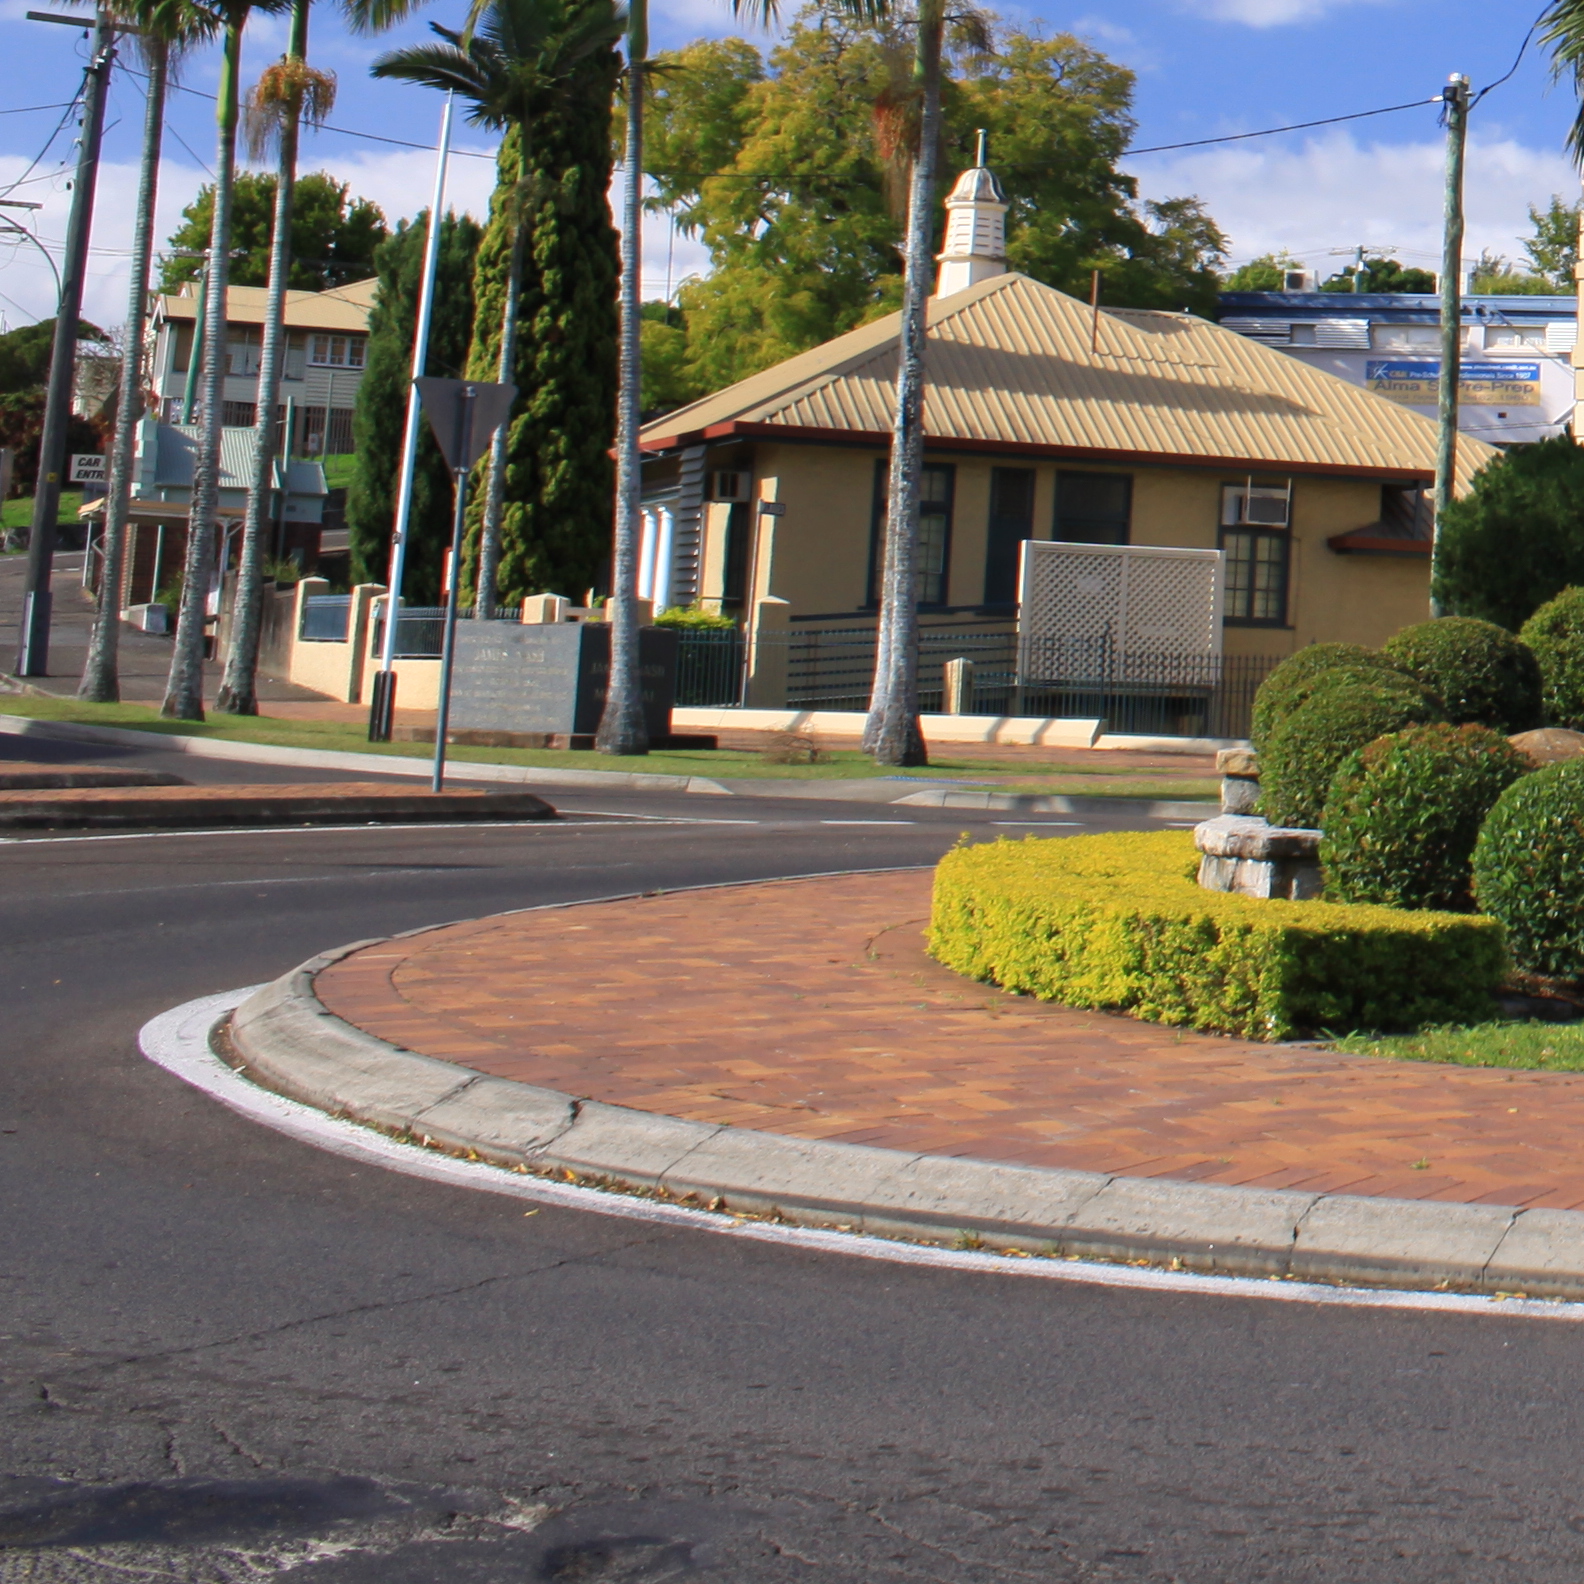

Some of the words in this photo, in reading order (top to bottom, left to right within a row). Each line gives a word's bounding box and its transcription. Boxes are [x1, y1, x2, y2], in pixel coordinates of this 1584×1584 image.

[1374, 380, 1420, 392] Alma
[78, 457, 101, 467] CAR
[76, 469, 105, 479] ENTR
